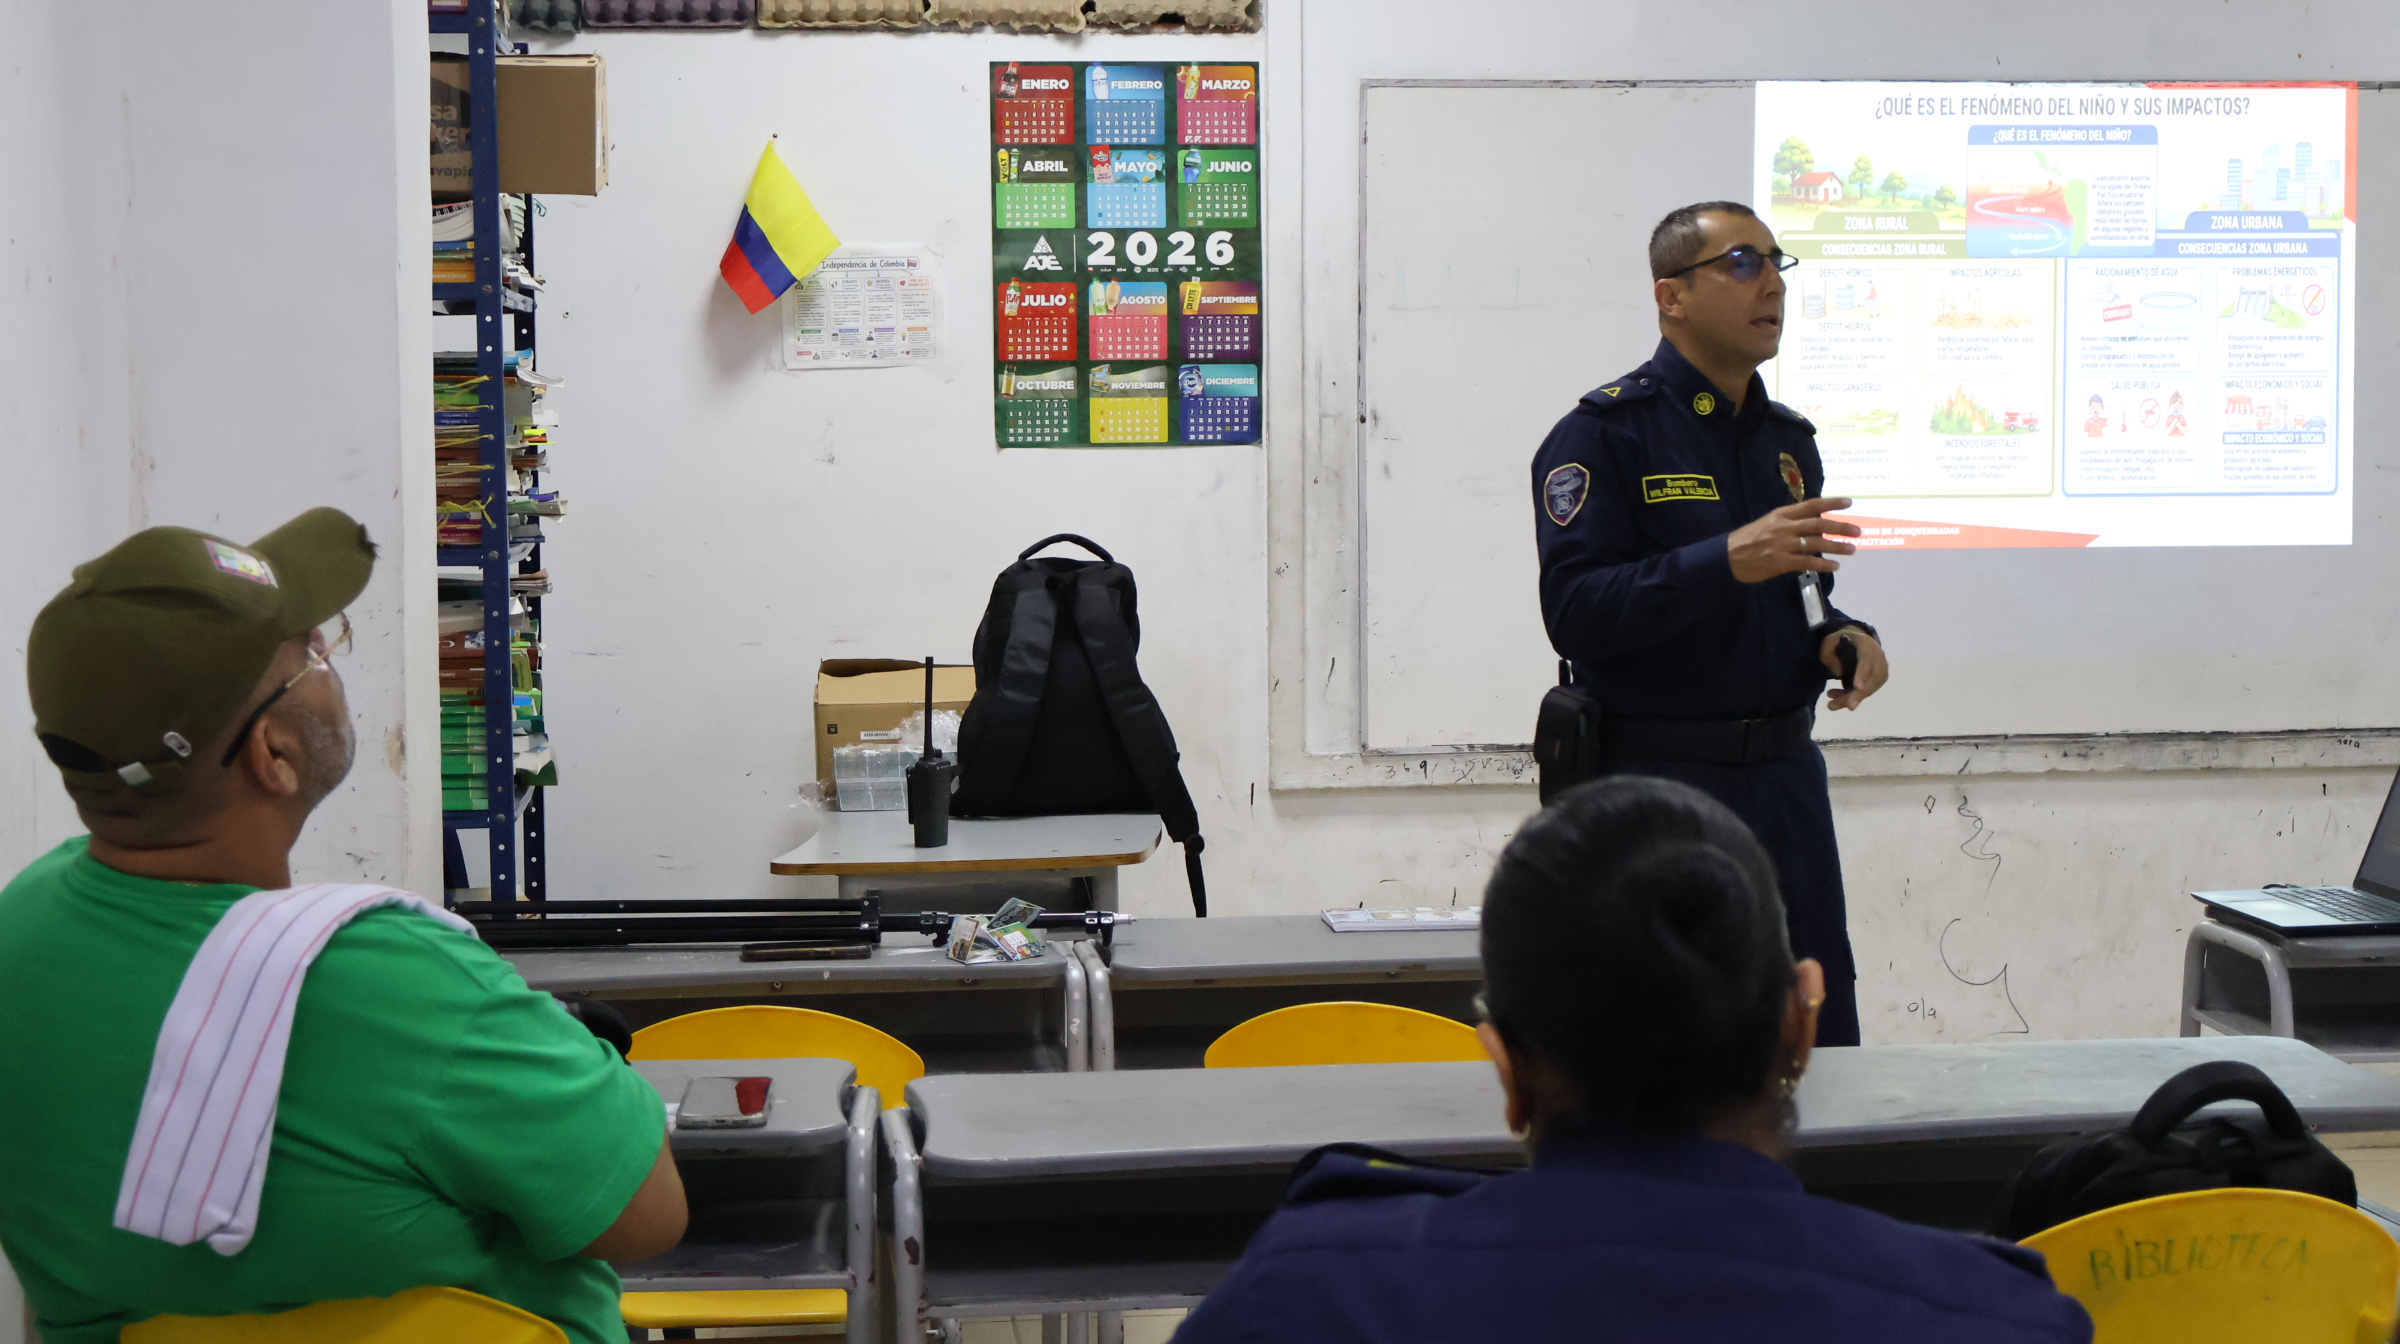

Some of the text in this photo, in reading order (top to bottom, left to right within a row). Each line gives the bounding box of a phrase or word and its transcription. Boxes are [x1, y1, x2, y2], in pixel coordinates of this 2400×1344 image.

[1022, 79, 1069, 89] ENERO
[1111, 81, 1162, 89] FEBRERO
[1202, 80, 1251, 90] MARZO
[1875, 93, 2250, 119] ¿QUÉ ES EL FENÓMENO DEL NIÑO Y SUS IMPACTOS?
[1992, 129, 2132, 144] ¿QUÉ ES EL FENÓMENO DEL NIÑO?
[1023, 161, 1068, 172] ABRIL
[1115, 162, 1157, 172] MAYO
[1206, 161, 1252, 172] JUNIO
[1844, 216, 1909, 231] ZONA RURAL
[2211, 216, 2283, 230] ZONA URBANA
[1087, 231, 1235, 266] 2026
[1821, 243, 1946, 256] CONSECUENCIAS ZONA RURAL
[2178, 242, 2308, 255] CONSECUENCIAS ZONA URBANA
[822, 259, 905, 270] Independencia de Colombia
[1023, 255, 1063, 271] AJE
[1949, 268, 1982, 277] IMPACTOS
[2096, 267, 2178, 276] RACIONAMIENTO DE AGUA
[2233, 266, 2317, 276] PROBLEMAS ENERGÉTICOS
[1021, 295, 1067, 306] JULIO
[1120, 296, 1165, 304] AGOSTO
[1017, 381, 1074, 390] OCTUBRE
[1807, 383, 1882, 391] IMPACTOS GANADEROS
[2111, 381, 2132, 390] SALUD
[2225, 380, 2252, 389] IMPACTO
[2295, 380, 2298, 388] Y
[2301, 380, 2322, 388] SOCIAL
[1944, 439, 2021, 447] INCENDIOS FORESTALES
[2224, 433, 2253, 443] IMPACTO
[2295, 433, 2299, 443] Y
[2300, 433, 2324, 443] SOCIAL
[1666, 479, 1698, 487] Bombero
[1683, 487, 1714, 495] VALENCIA
[1882, 527, 1893, 535] DE
[1894, 527, 1960, 536] DOSQUEBRADAS
[1419, 760, 1427, 778] 9
[2088, 1228, 2309, 1289] BIBLIOTECA
